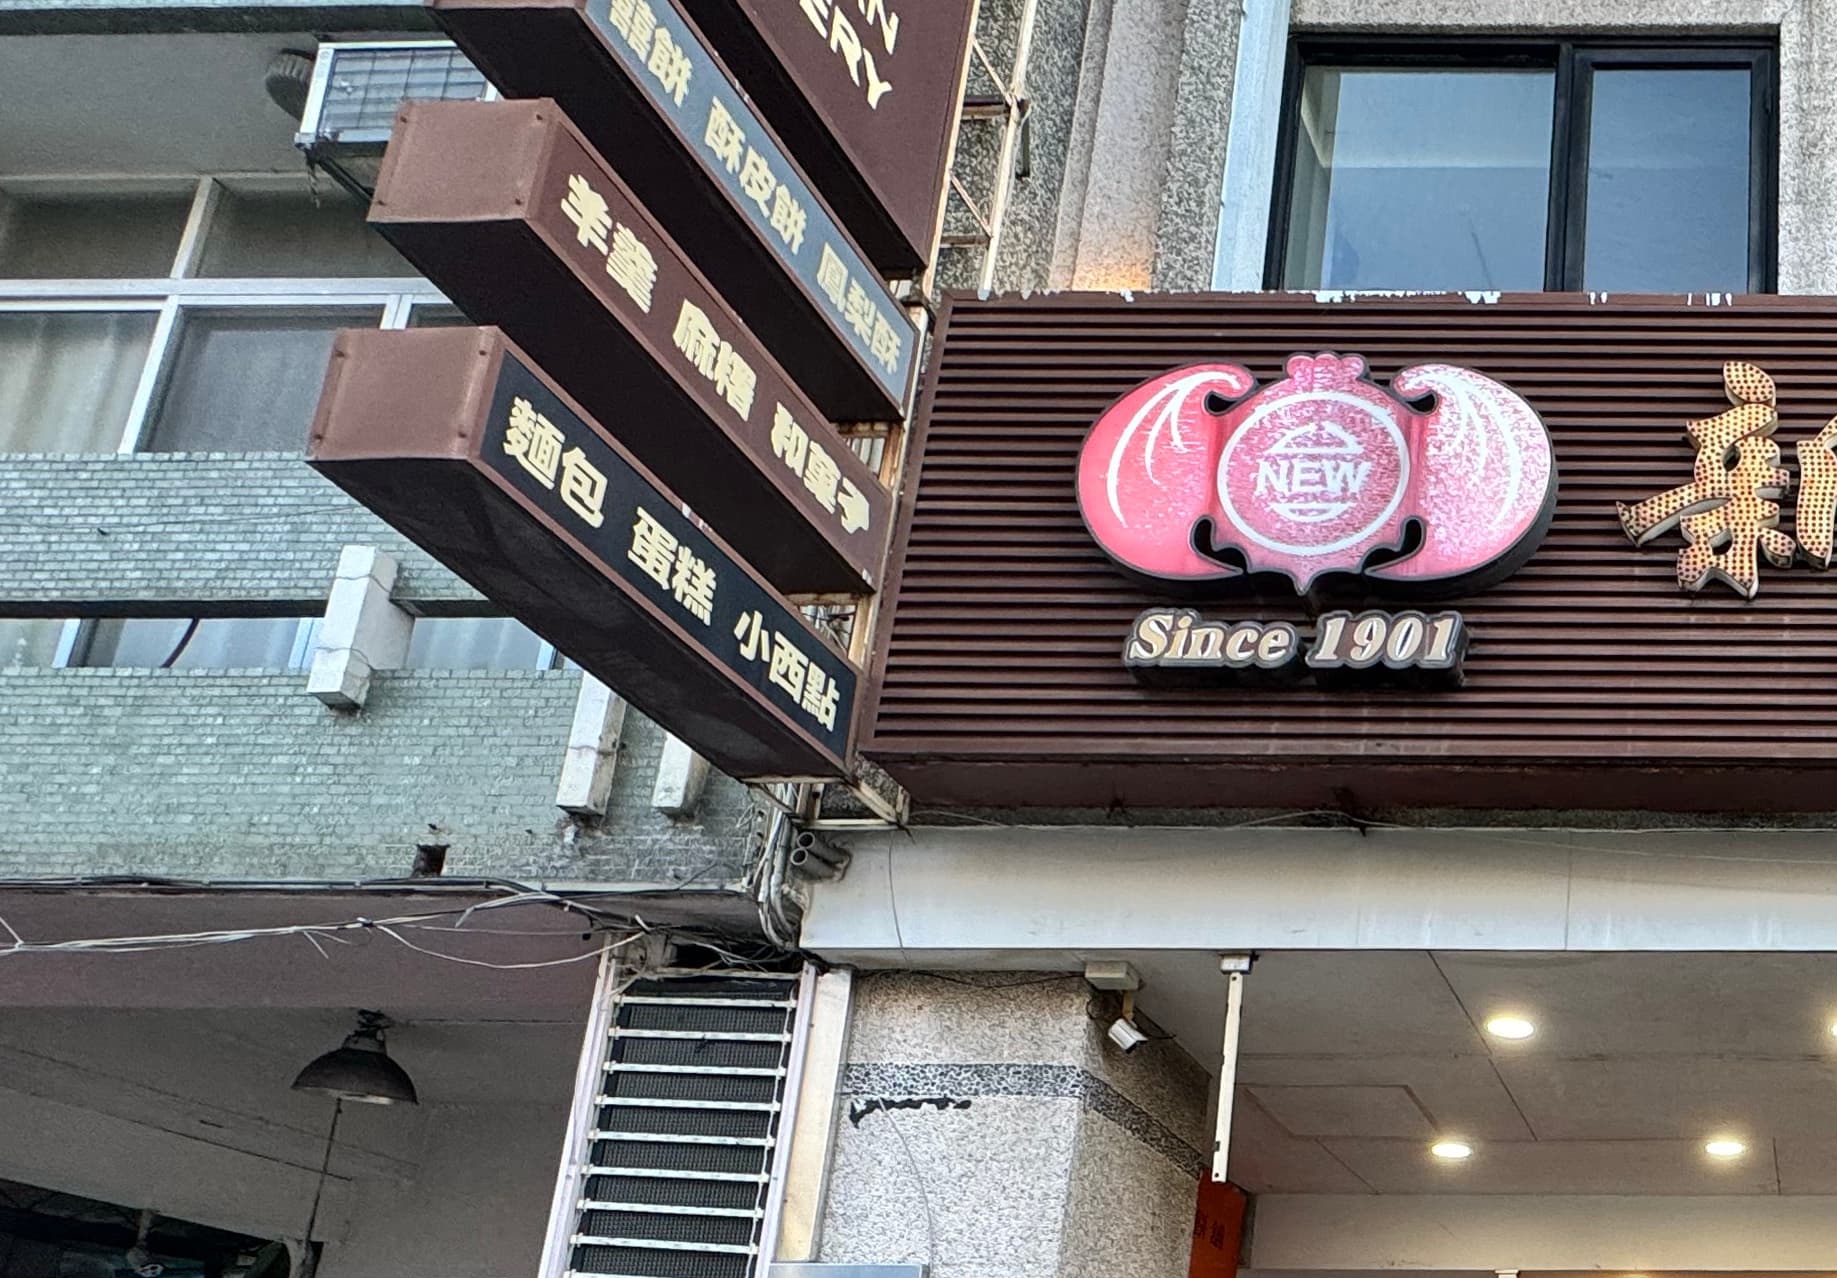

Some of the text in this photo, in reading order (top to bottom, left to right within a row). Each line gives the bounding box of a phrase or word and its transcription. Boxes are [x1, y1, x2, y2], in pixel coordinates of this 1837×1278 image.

[560, 173, 870, 535] 羊羹 麻糬 和菓子
[704, 96, 807, 256] 酥皮餅
[816, 242, 902, 375] 鳳梨酥
[503, 395, 841, 733] 麵包 蛋糕 小西點
[1256, 459, 1373, 497] NEW
[1126, 611, 1458, 665] Since 1901
